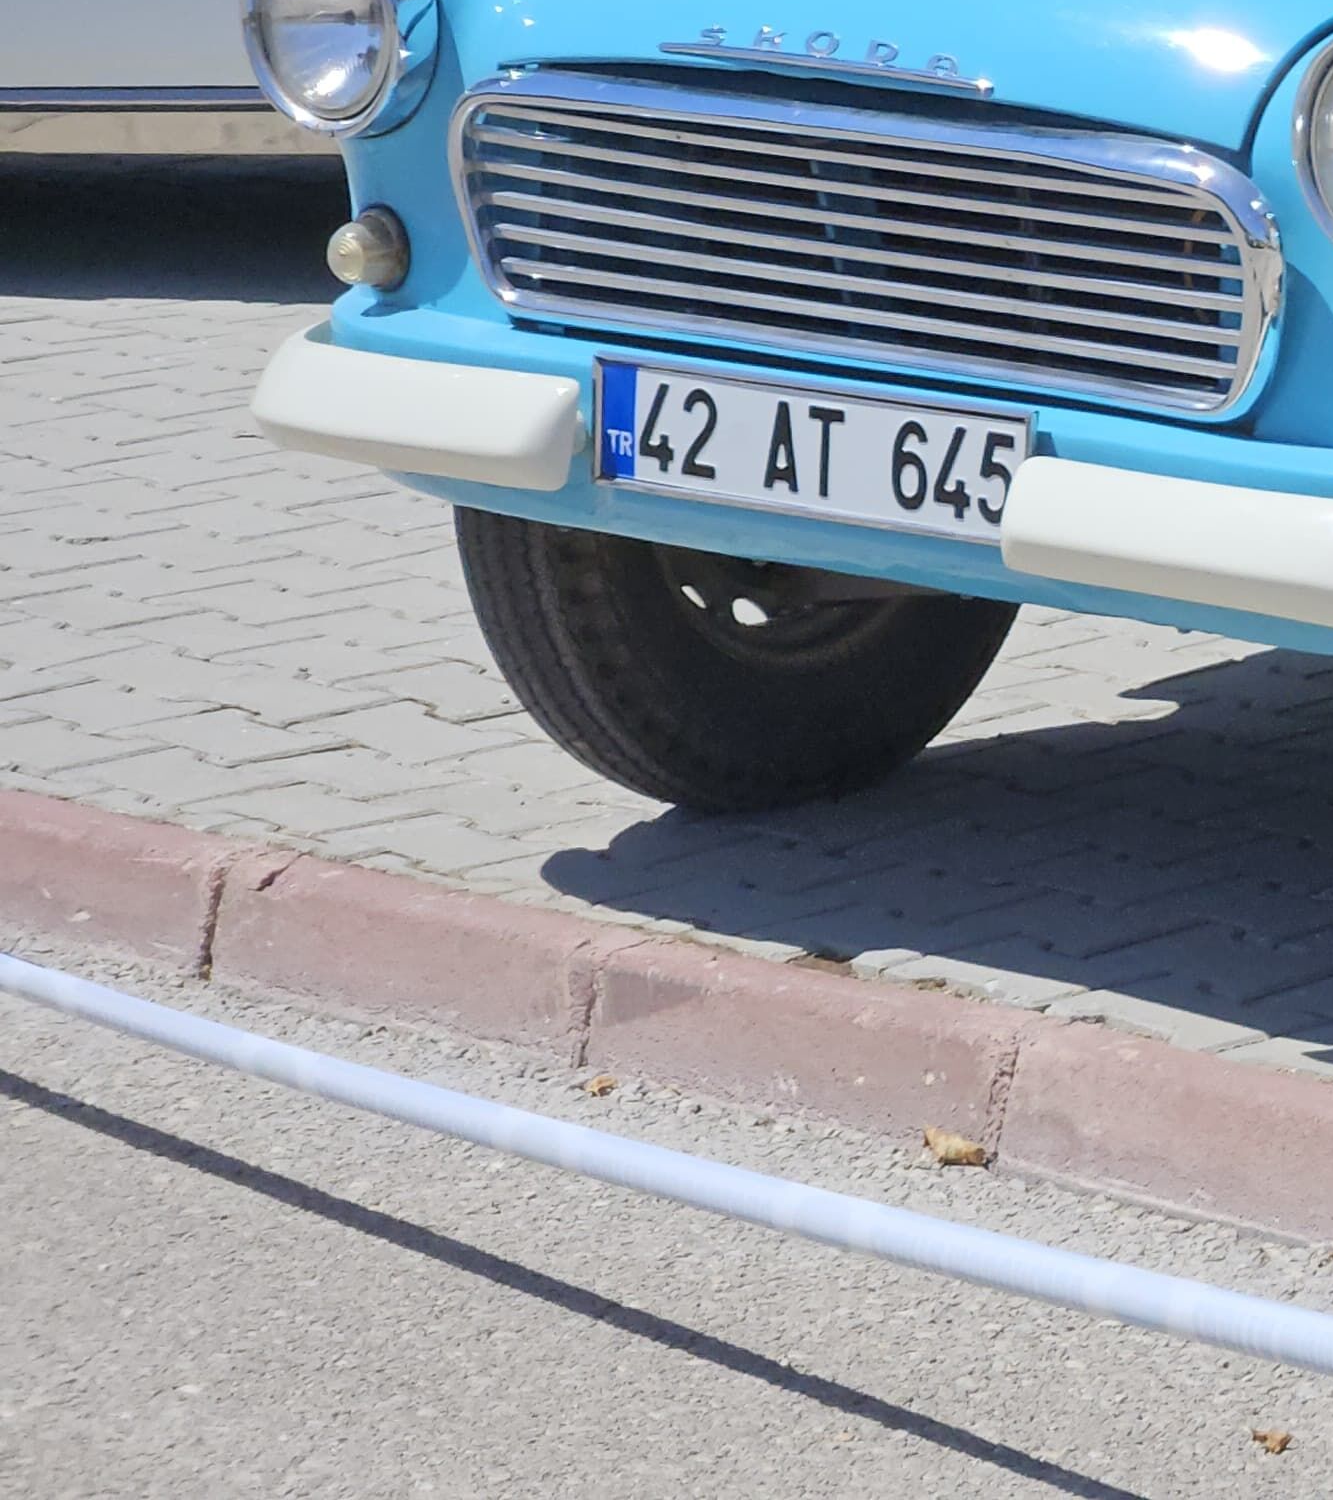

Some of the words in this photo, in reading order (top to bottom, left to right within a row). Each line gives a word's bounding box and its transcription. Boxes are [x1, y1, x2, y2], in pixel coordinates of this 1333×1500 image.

[607, 429, 633, 458] TR
[639, 383, 717, 480] 42
[763, 400, 846, 498] AT
[891, 420, 1016, 525] 645
